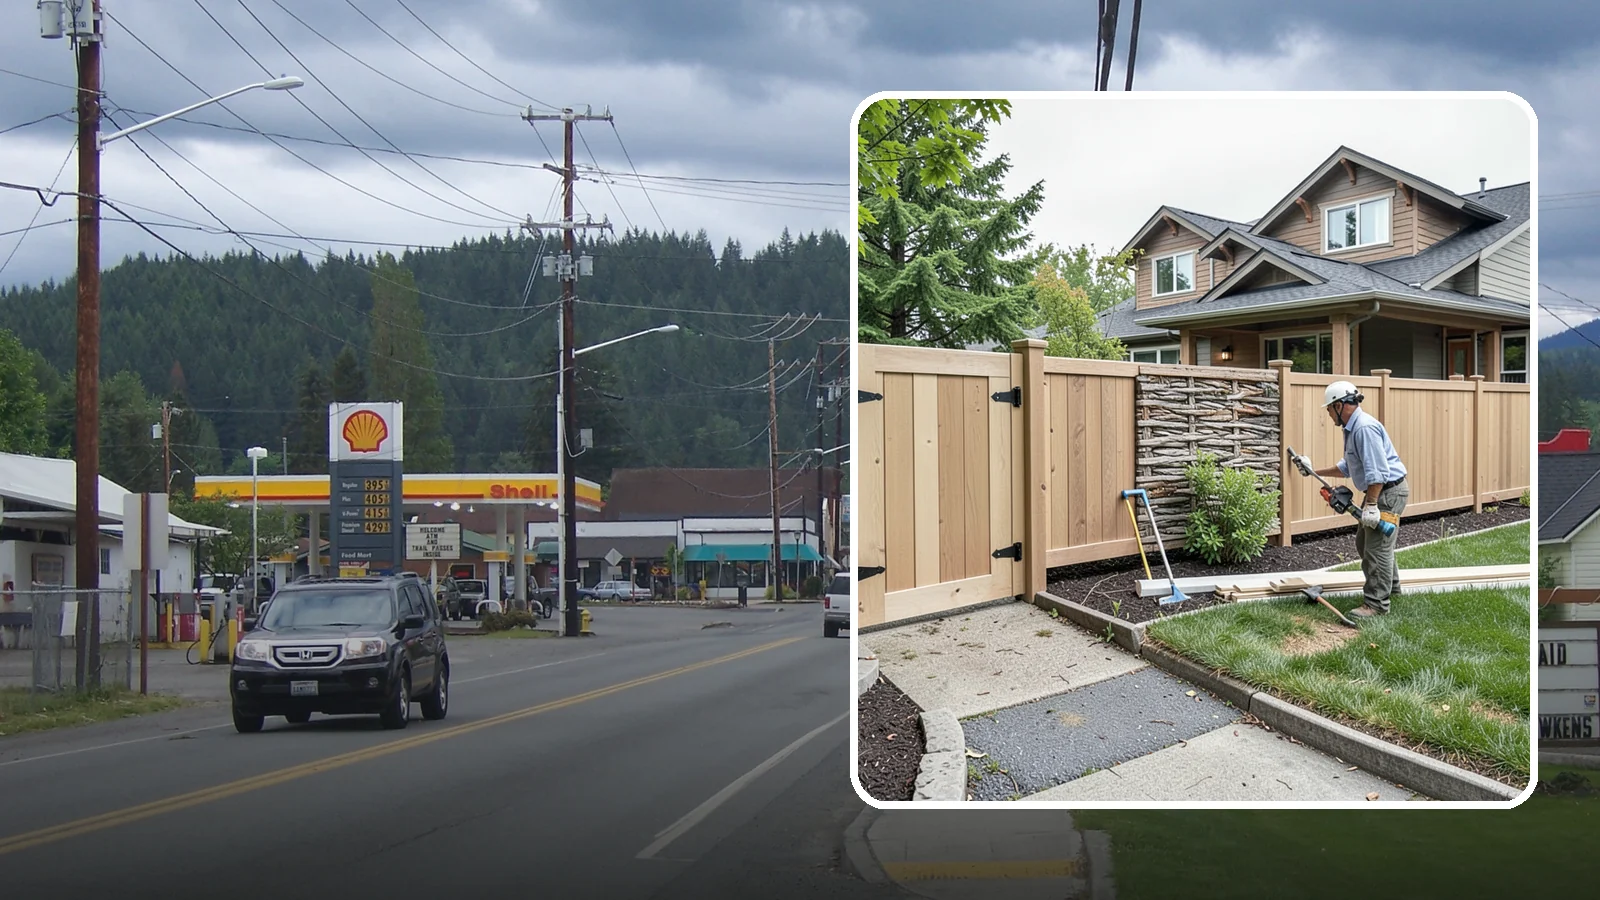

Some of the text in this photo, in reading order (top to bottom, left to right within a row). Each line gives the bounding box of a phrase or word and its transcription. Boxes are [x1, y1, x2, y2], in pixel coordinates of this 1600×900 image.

[366, 480, 383, 490] 395
[490, 484, 547, 499] Shell
[366, 494, 383, 504] 405
[366, 508, 383, 518] 415
[366, 522, 383, 533] 429
